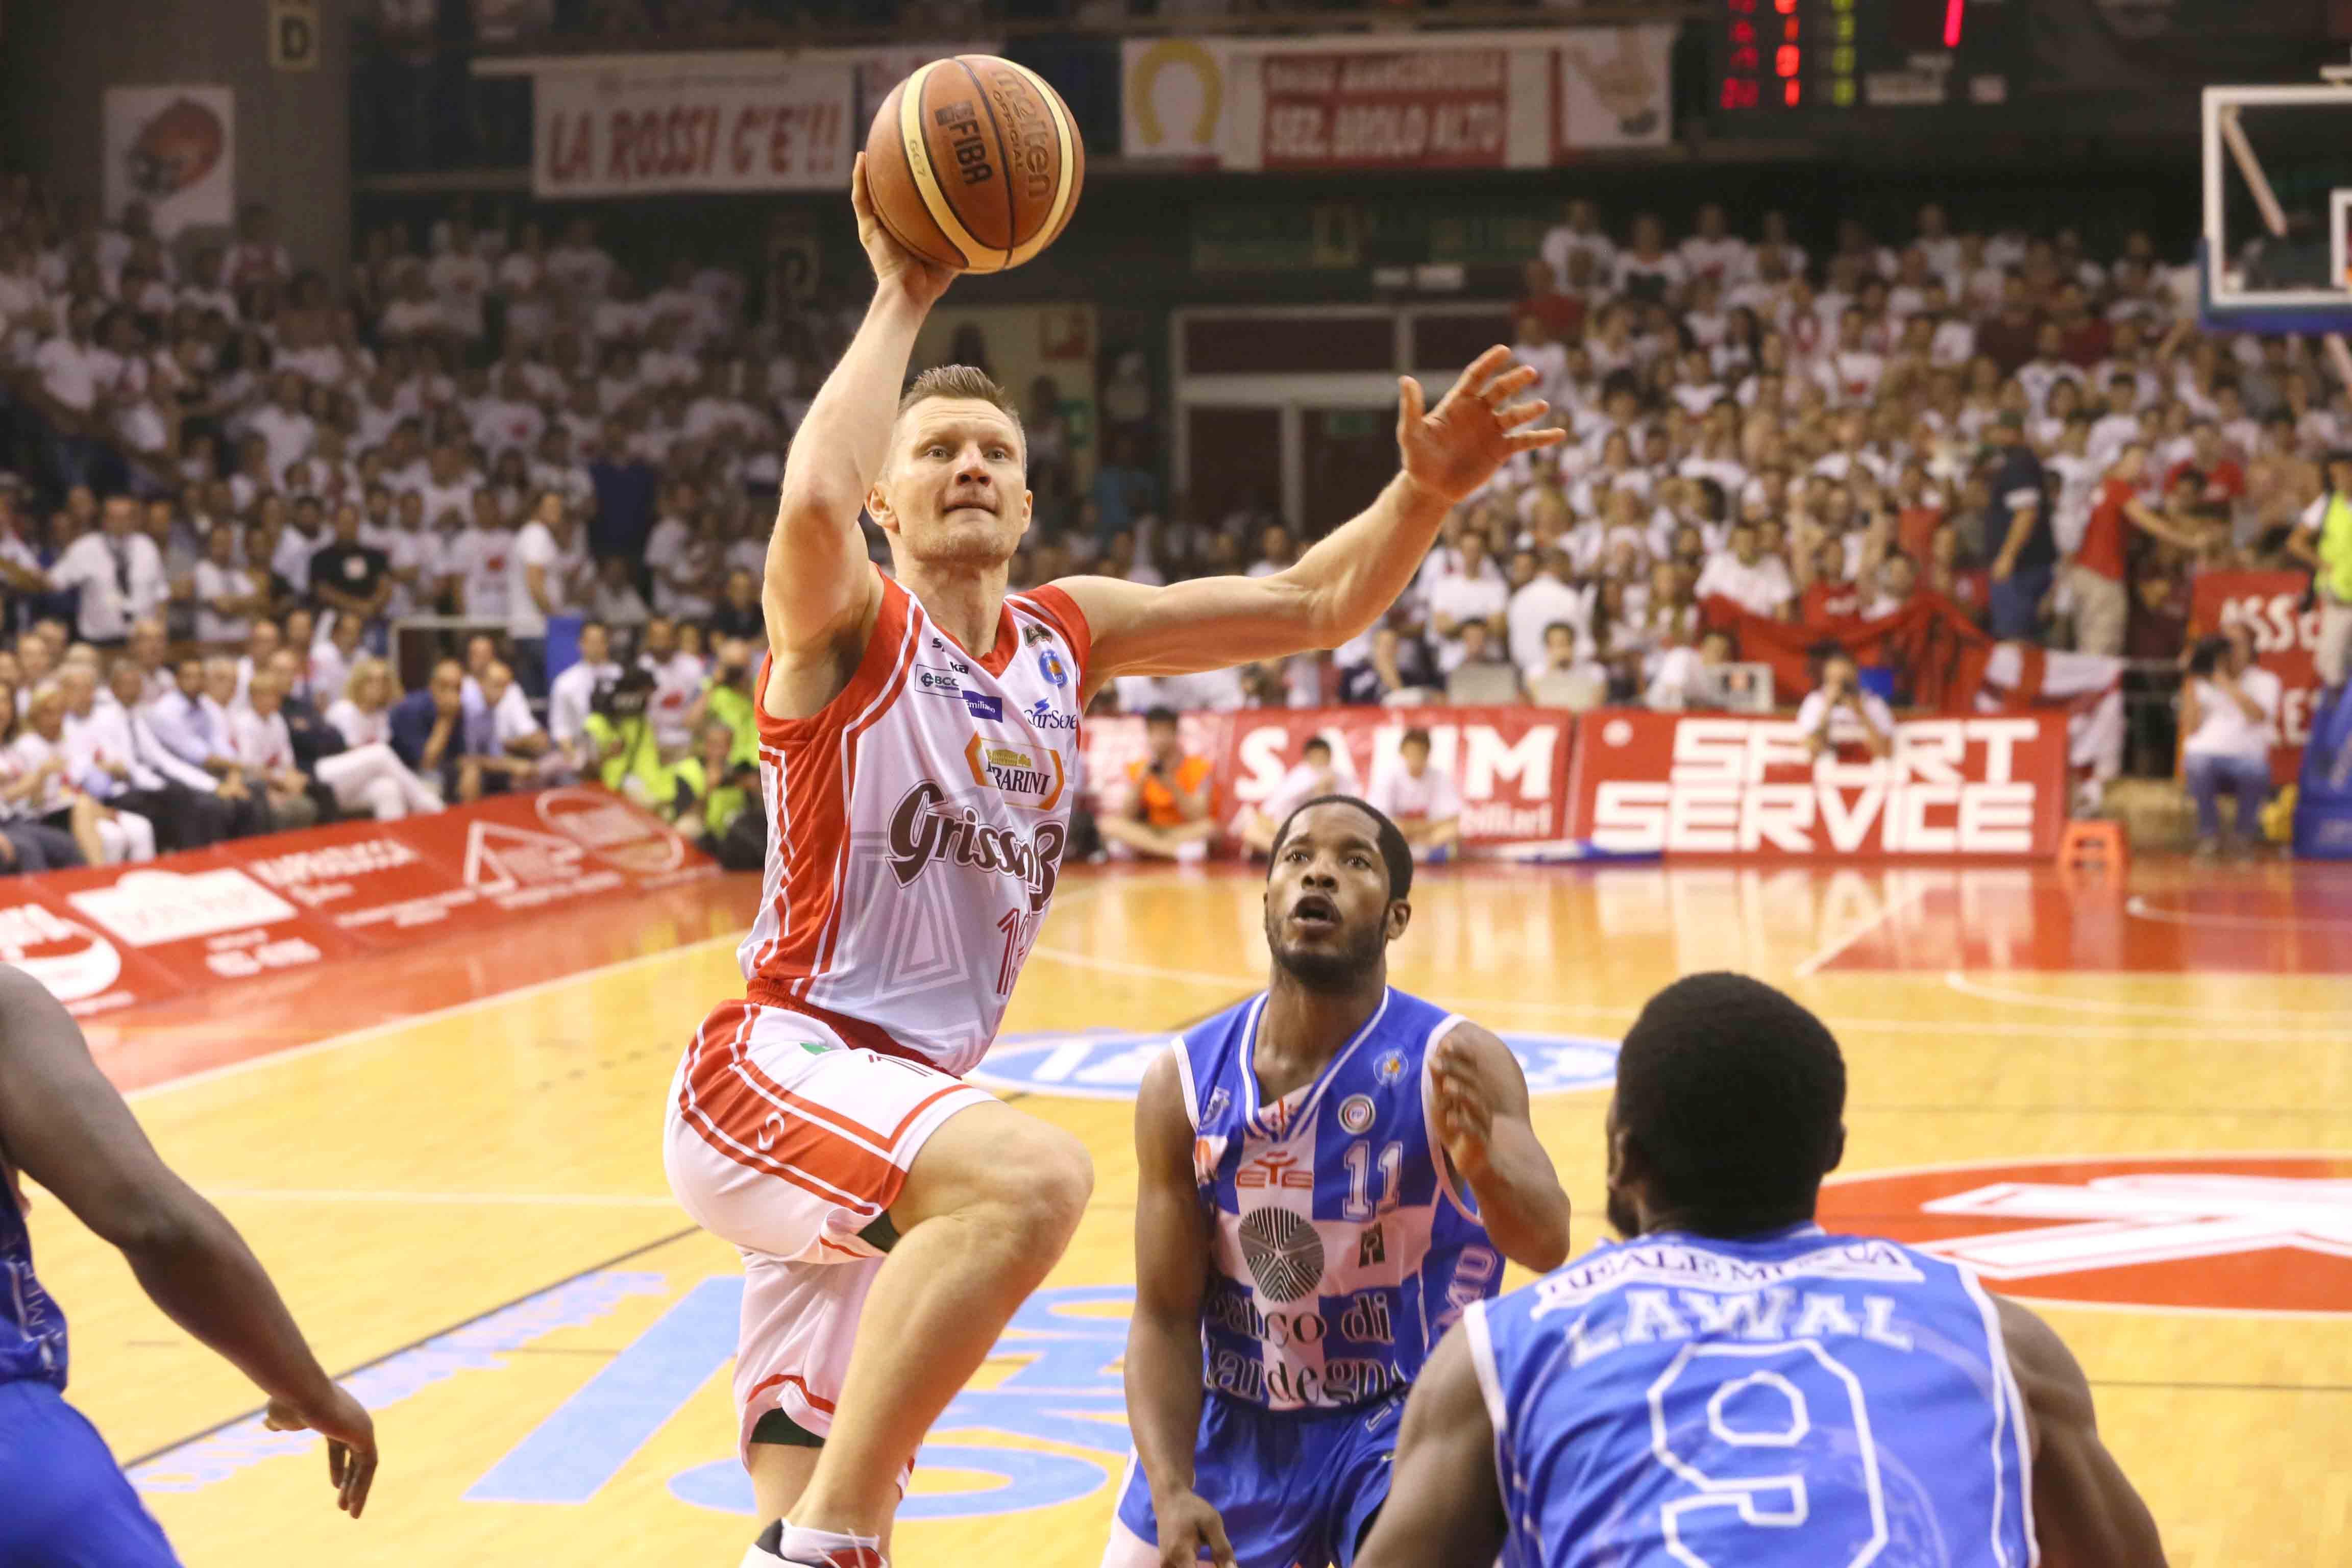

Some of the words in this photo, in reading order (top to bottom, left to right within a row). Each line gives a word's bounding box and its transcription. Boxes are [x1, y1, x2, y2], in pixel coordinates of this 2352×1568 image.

[549, 111, 592, 183] LA
[607, 104, 719, 182] ROSSI
[948, 119, 993, 184] FIBA
[1592, 782, 2036, 852] SERVICE
[996, 908, 1029, 996] 1
[1343, 1141, 1404, 1222] 11
[1214, 1290, 1327, 1349] anco
[1341, 1292, 1395, 1345] di
[1568, 1287, 1914, 1368] LAWAL
[1204, 1336, 1407, 1405] ardegn
[1648, 1338, 1890, 1568] 9
